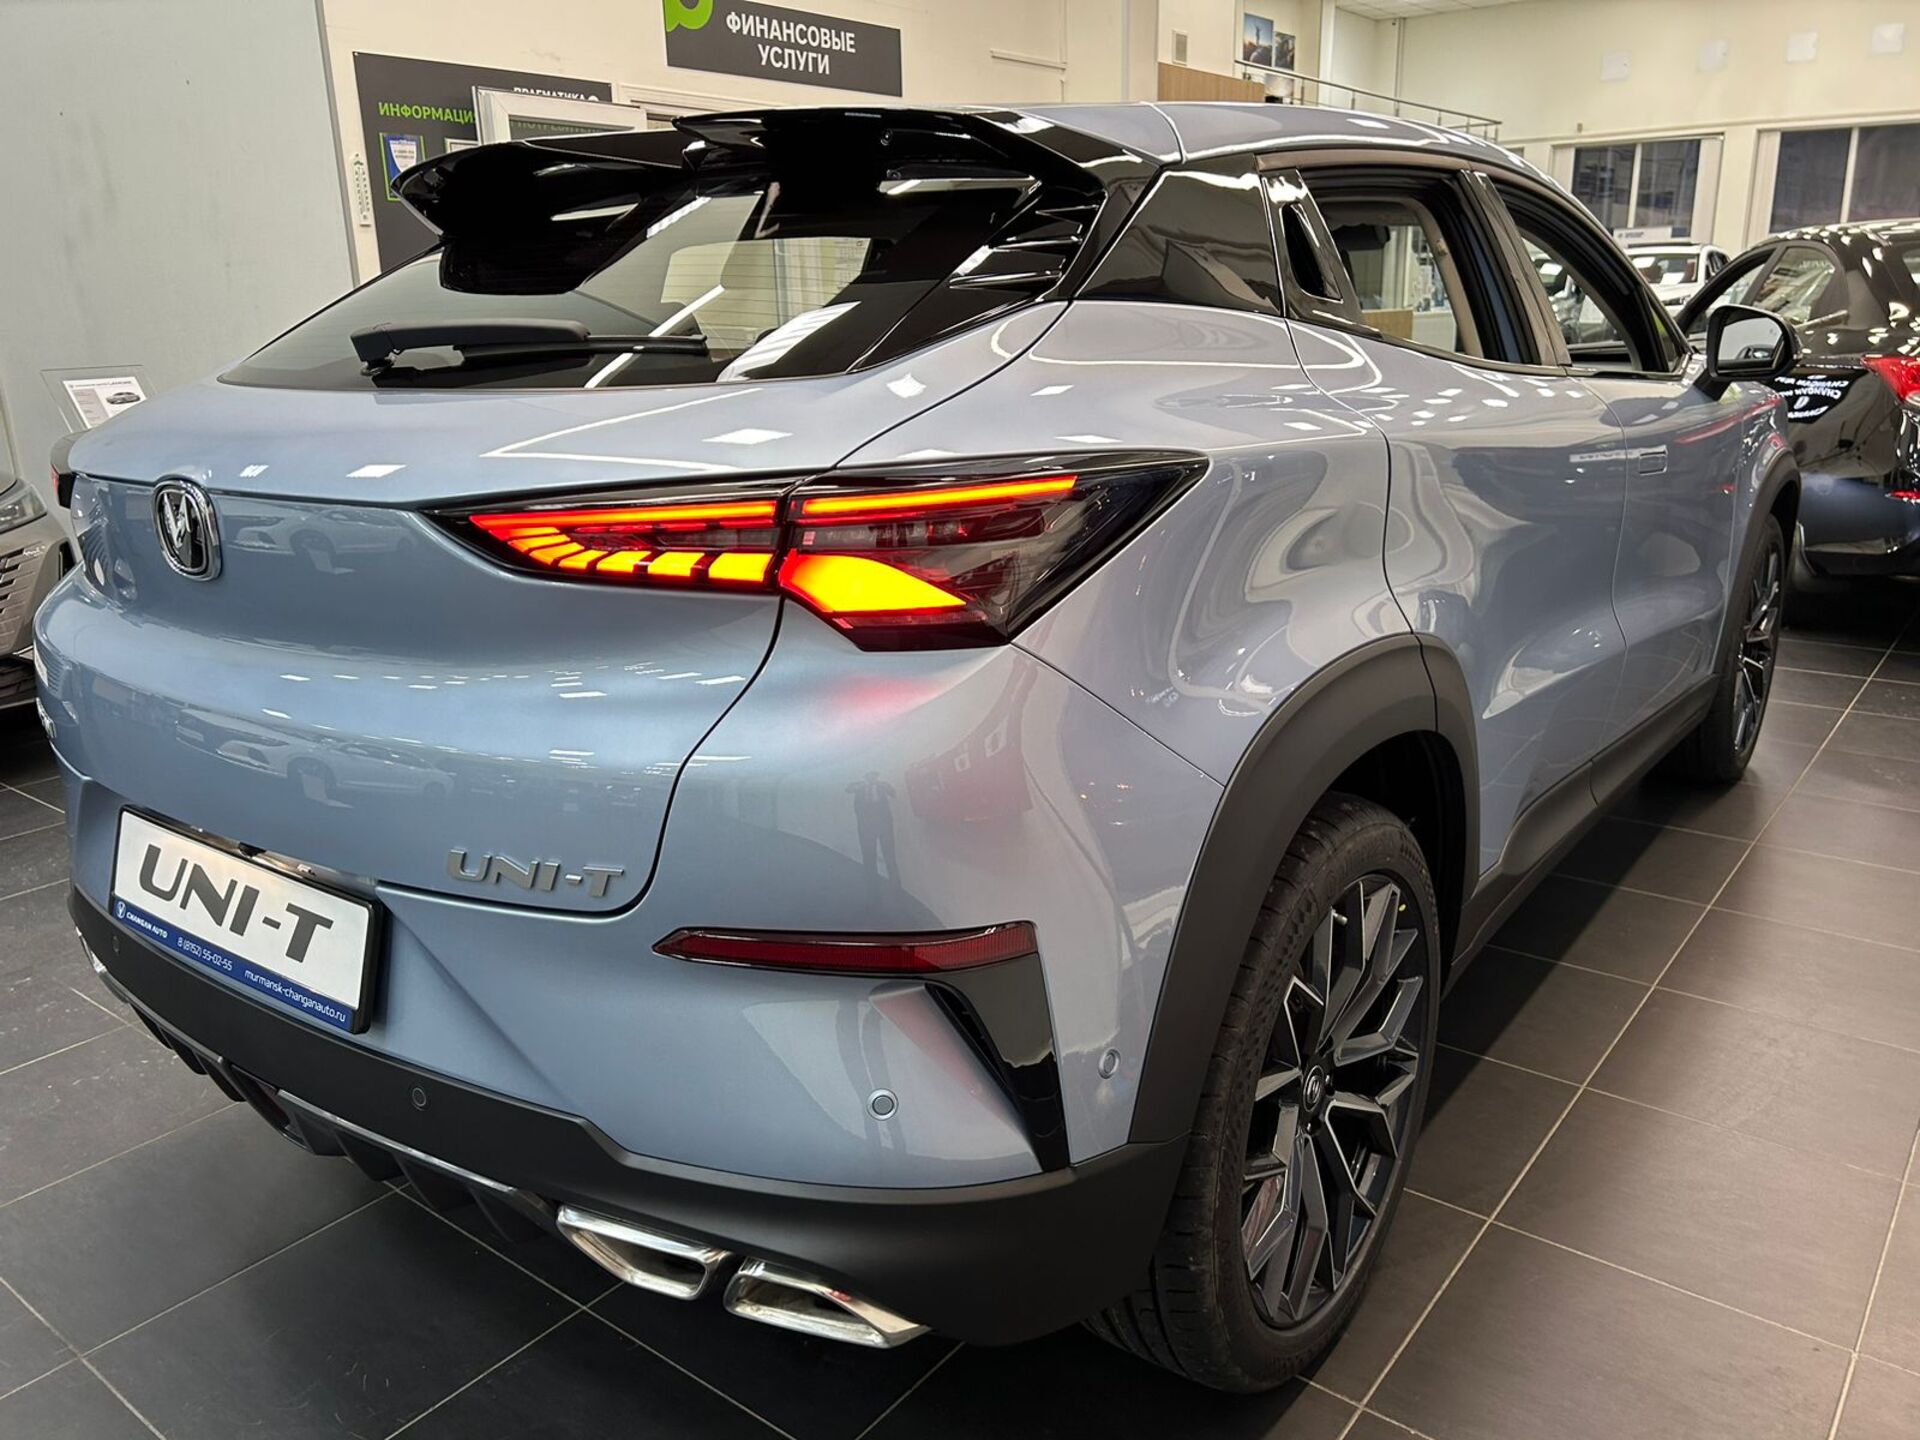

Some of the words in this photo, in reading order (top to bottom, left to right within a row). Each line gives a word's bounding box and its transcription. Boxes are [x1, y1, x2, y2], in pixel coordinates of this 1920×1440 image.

[726, 12, 856, 53] ФИНАНСОВЫЕ
[758, 44, 830, 75] УСЛУГИ
[379, 102, 474, 124] ИНФОРМАЦИ
[449, 848, 625, 897] UNI-T
[139, 844, 334, 963] UNI-T
[177, 937, 183, 948] 8
[202, 948, 233, 971] 55-02-55
[244, 969, 346, 1023] murmansk-changanauto.ru
